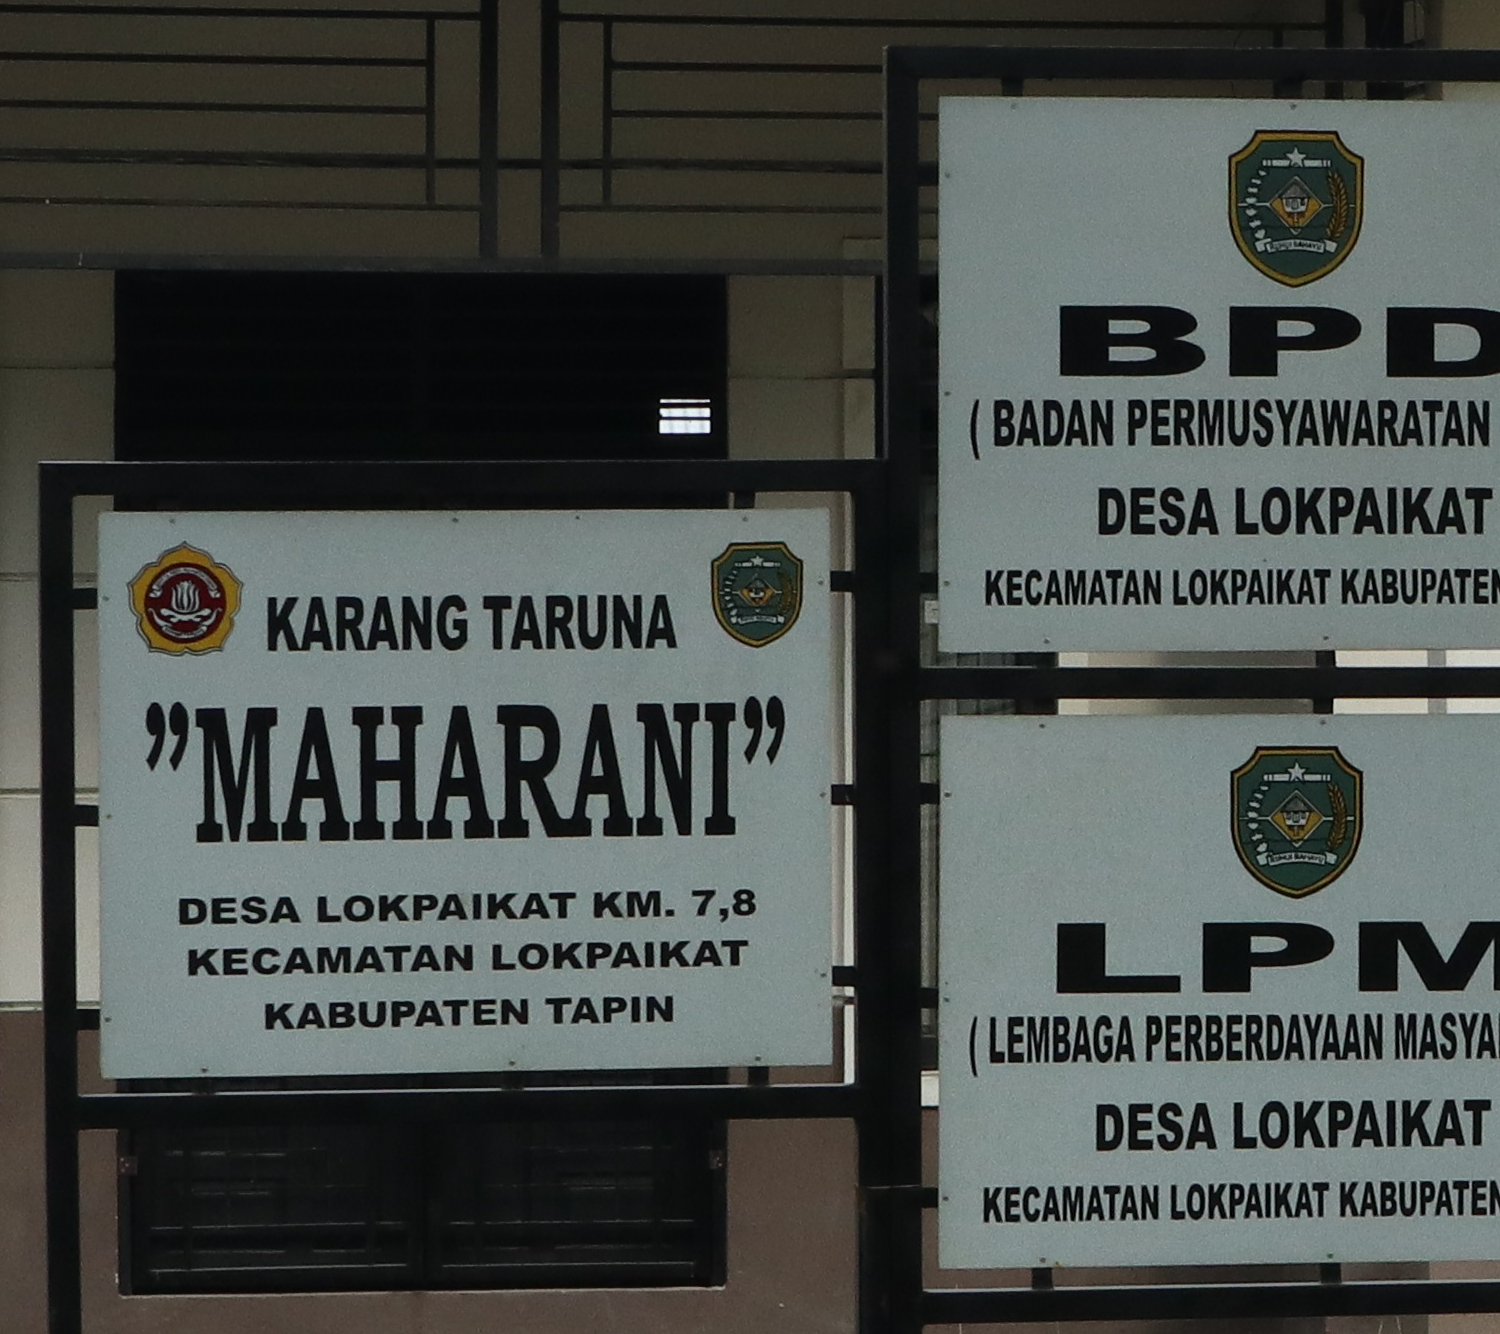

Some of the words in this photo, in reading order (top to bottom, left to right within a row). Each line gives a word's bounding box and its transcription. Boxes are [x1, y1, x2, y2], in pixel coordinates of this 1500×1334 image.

[1128, 399, 1489, 447] PERMUSYAWARATAN
[1099, 487, 1219, 536] DESA
[1236, 487, 1493, 535] LOKPAIKAT
[986, 570, 1161, 606] KECAMATAN
[1173, 569, 1331, 605] LOKPAIKAT
[268, 595, 467, 651] KARANG
[483, 595, 677, 650] TARUNA
[179, 897, 300, 925] DESA
[318, 893, 576, 922] LOKPAIKAT
[594, 891, 674, 918] KM.
[692, 889, 756, 922] 7,8
[188, 945, 473, 976] KECAMATAN
[492, 940, 748, 970] LOKPAIKAT
[265, 999, 528, 1030] KABUPATEN
[545, 996, 673, 1024] TAPIN
[1146, 1014, 1383, 1061] PERBERDAYAAN
[1096, 1103, 1217, 1151] DESA
[1234, 1100, 1491, 1149] LOKPAIKAT
[984, 1185, 1158, 1223] KECAMATAN
[1171, 1182, 1329, 1220] LOKPAIKAT
